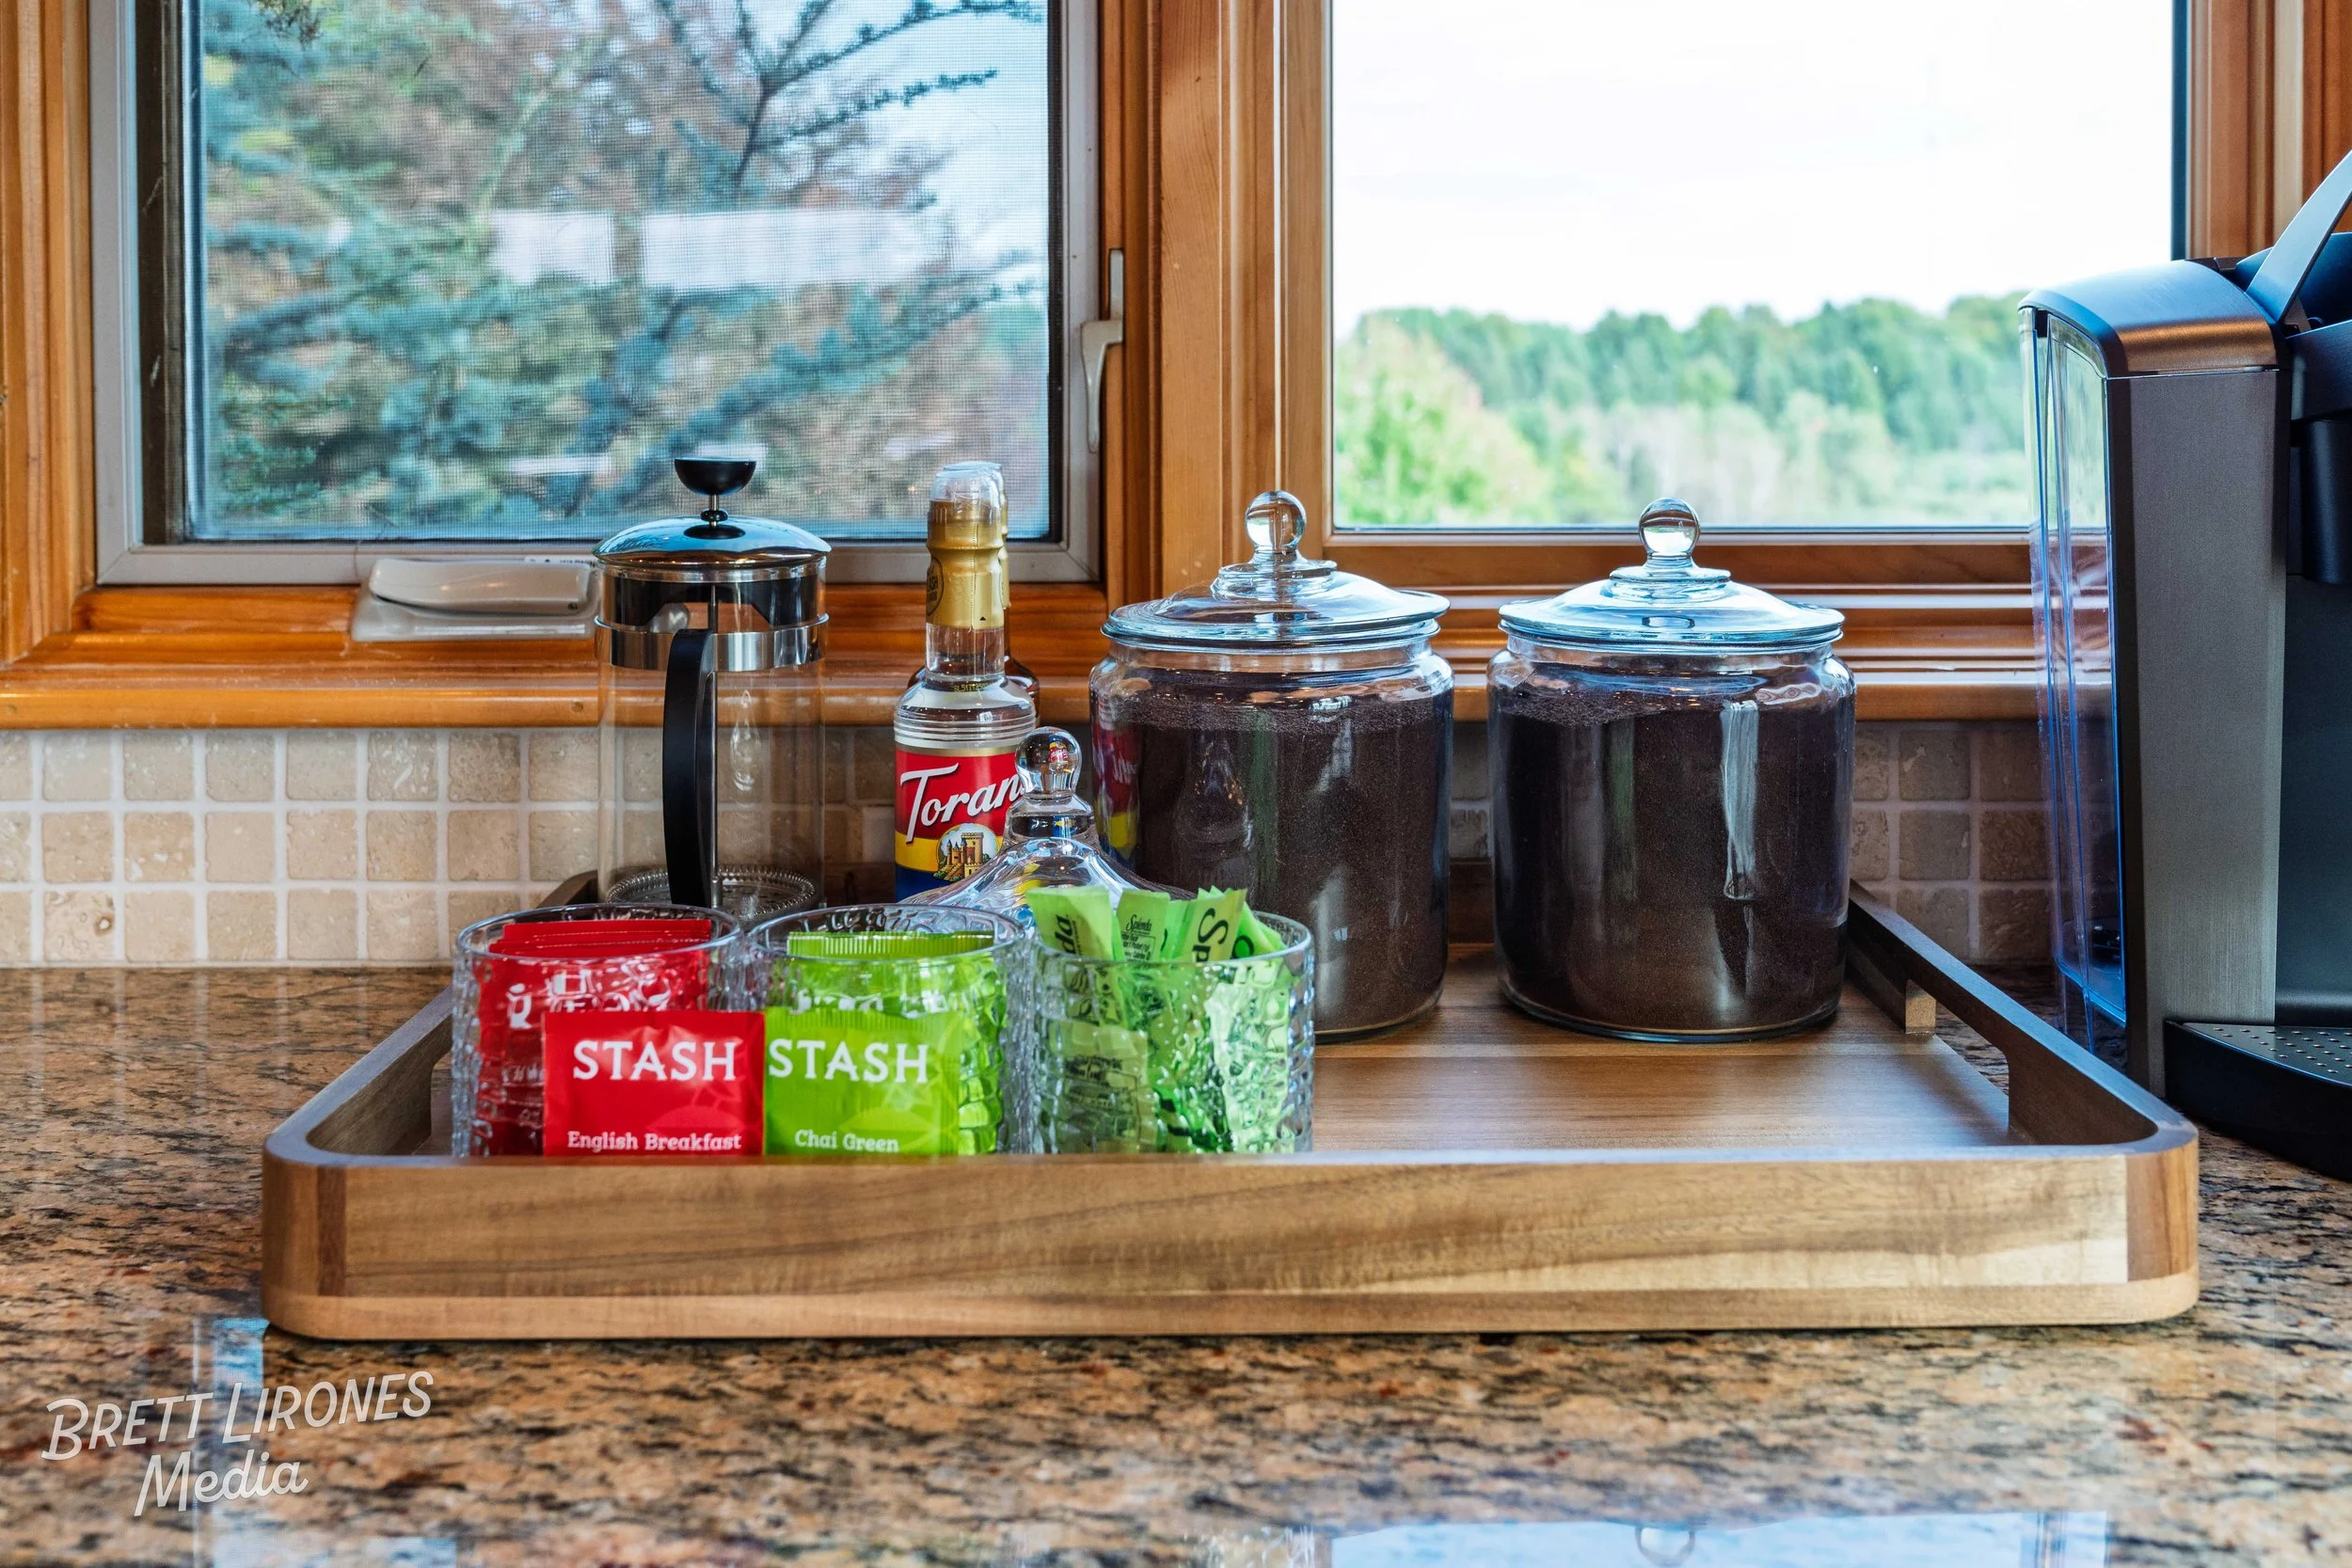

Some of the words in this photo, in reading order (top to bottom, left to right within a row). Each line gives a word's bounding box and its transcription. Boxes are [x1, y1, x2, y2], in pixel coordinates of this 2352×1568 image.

[900, 763, 1024, 843] Toran
[572, 1039, 738, 1082] STASH
[769, 1038, 930, 1084] STASH
[566, 1131, 638, 1153] English
[644, 1132, 742, 1151] Breakfast
[794, 1129, 837, 1149] Chai
[843, 1132, 899, 1153] Green
